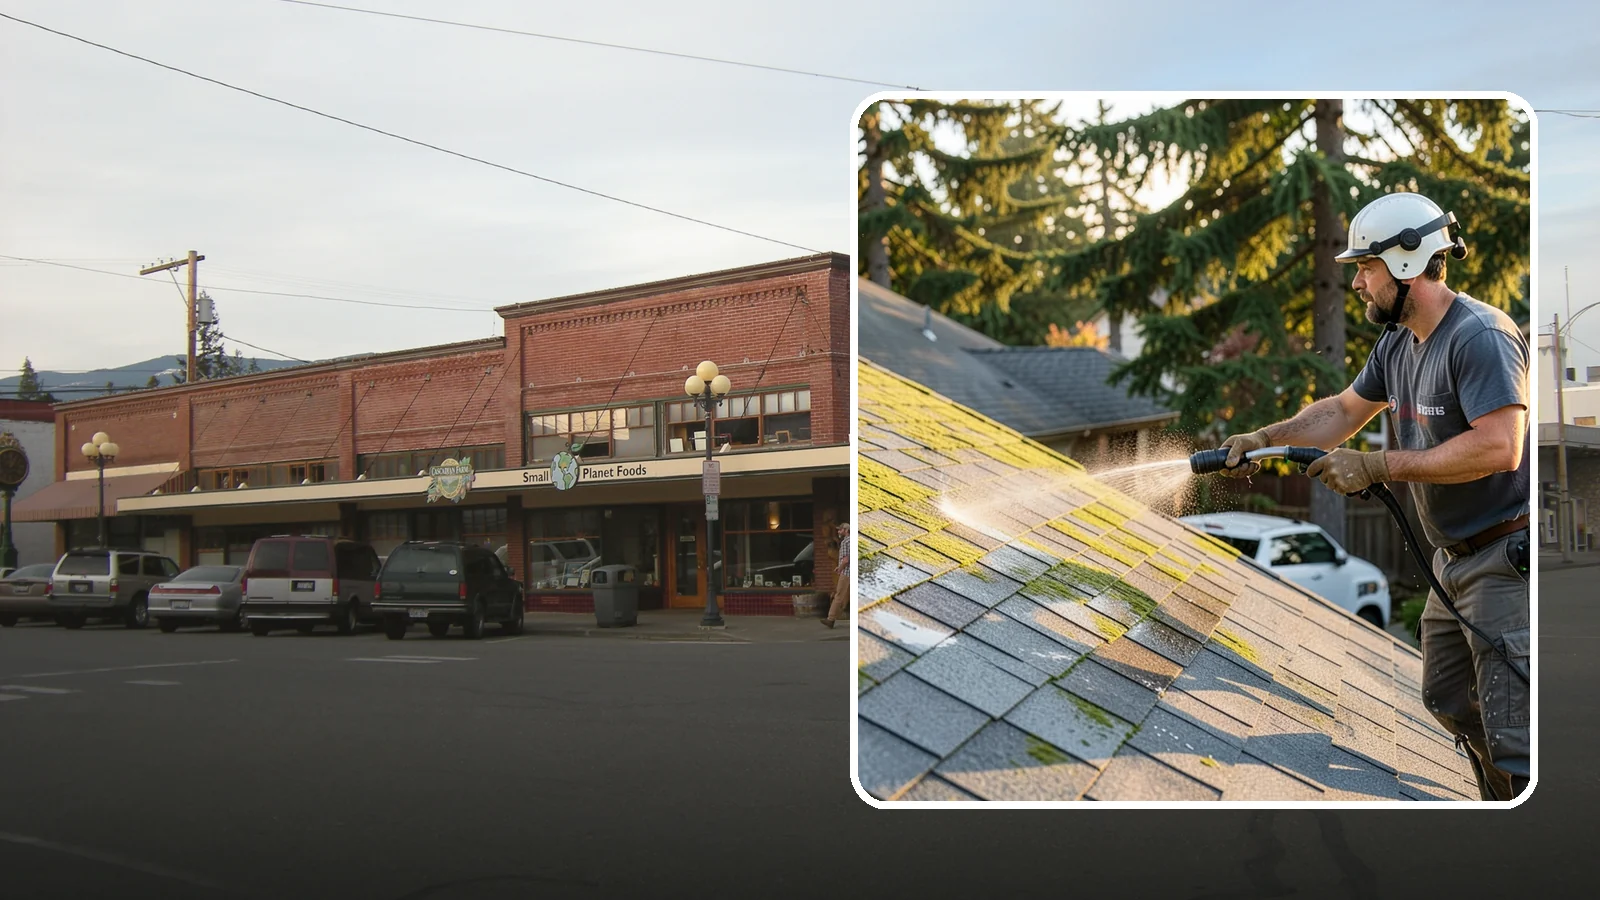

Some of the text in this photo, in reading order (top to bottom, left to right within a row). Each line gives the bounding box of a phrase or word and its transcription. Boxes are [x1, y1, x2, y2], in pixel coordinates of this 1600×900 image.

[523, 464, 647, 483] Small Planet Foods
